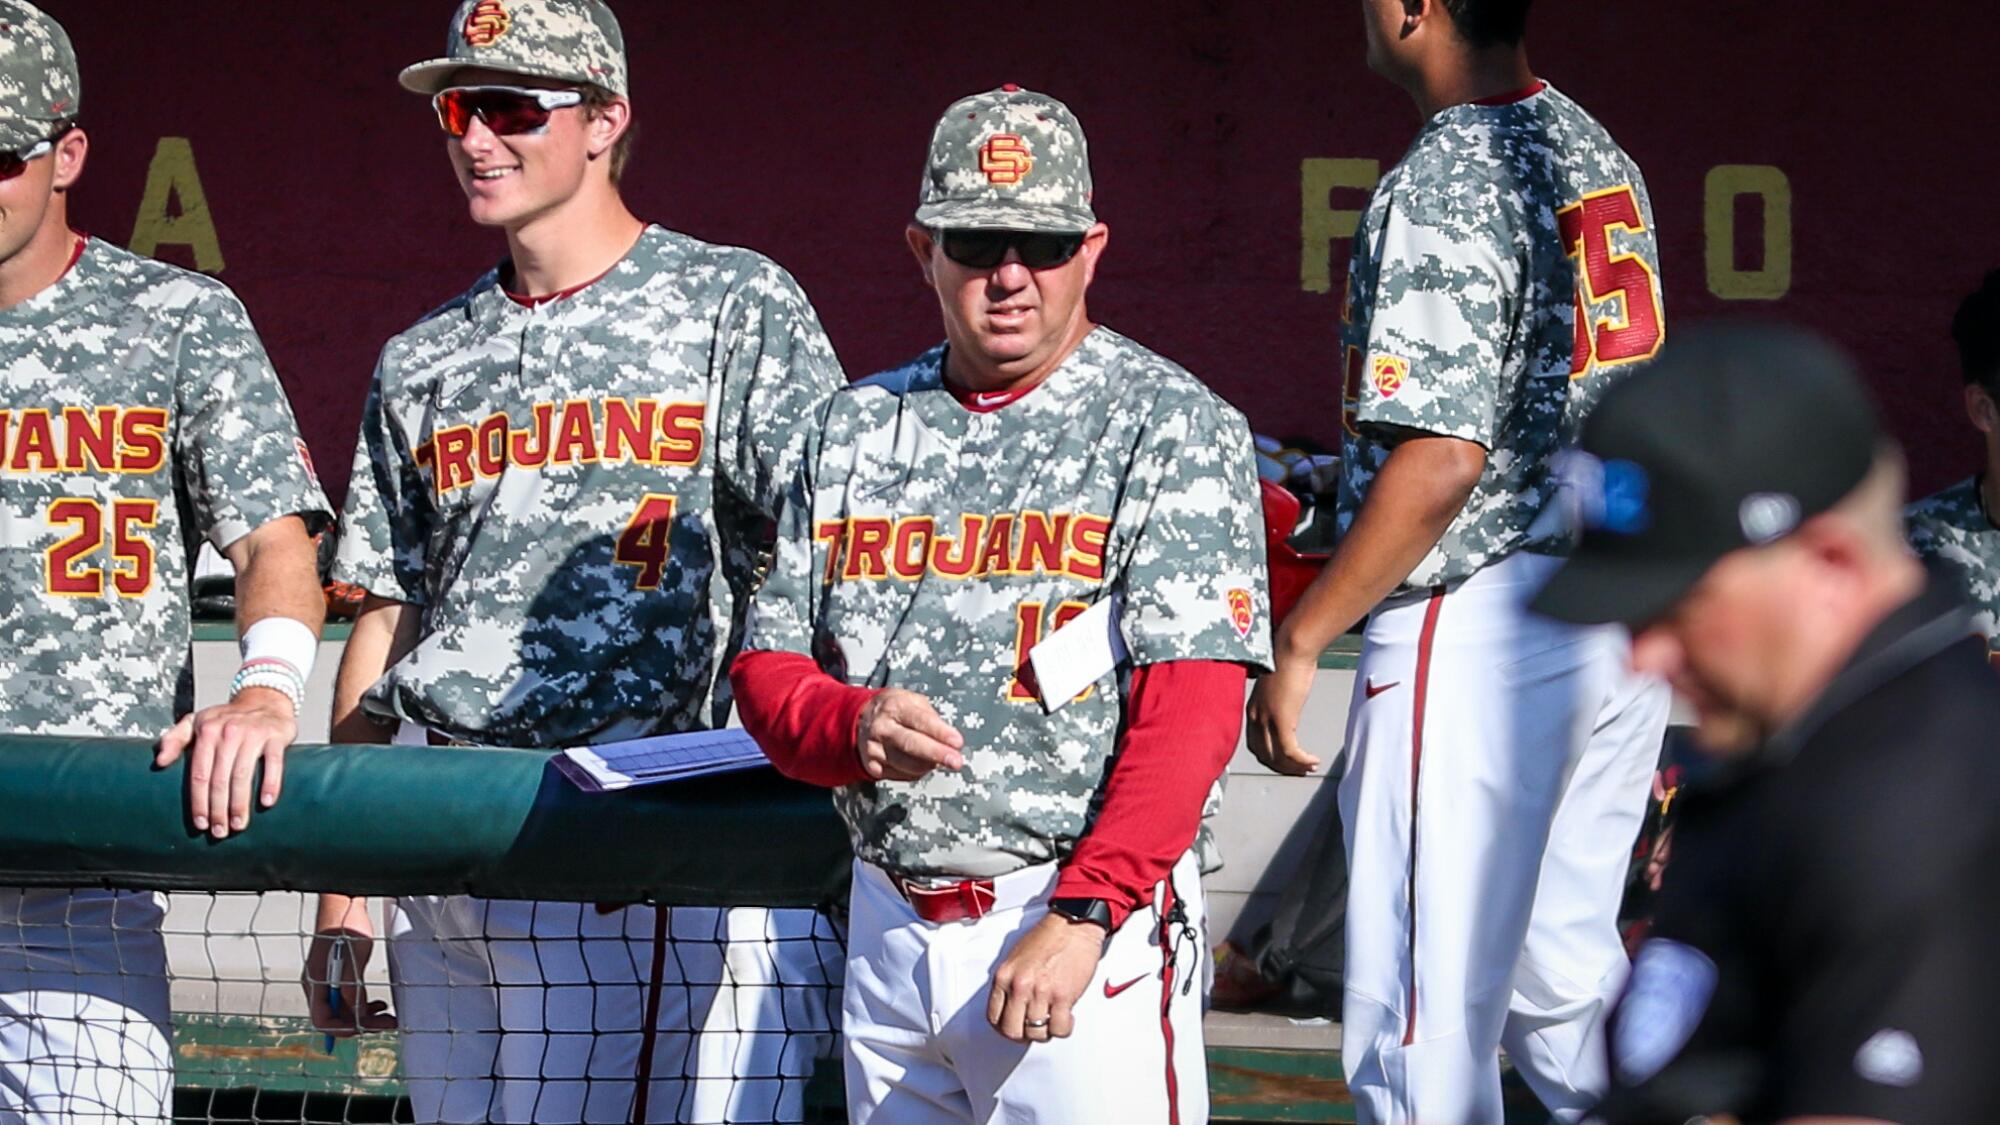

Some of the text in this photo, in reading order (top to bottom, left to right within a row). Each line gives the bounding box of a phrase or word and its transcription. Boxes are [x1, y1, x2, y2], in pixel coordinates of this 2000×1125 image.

[129, 137, 226, 274] A
[0, 406, 169, 474] ANS
[45, 497, 158, 598] 25
[613, 493, 678, 590] 4
[815, 509, 1112, 586] TROJANS
[1007, 601, 1096, 702] 1
